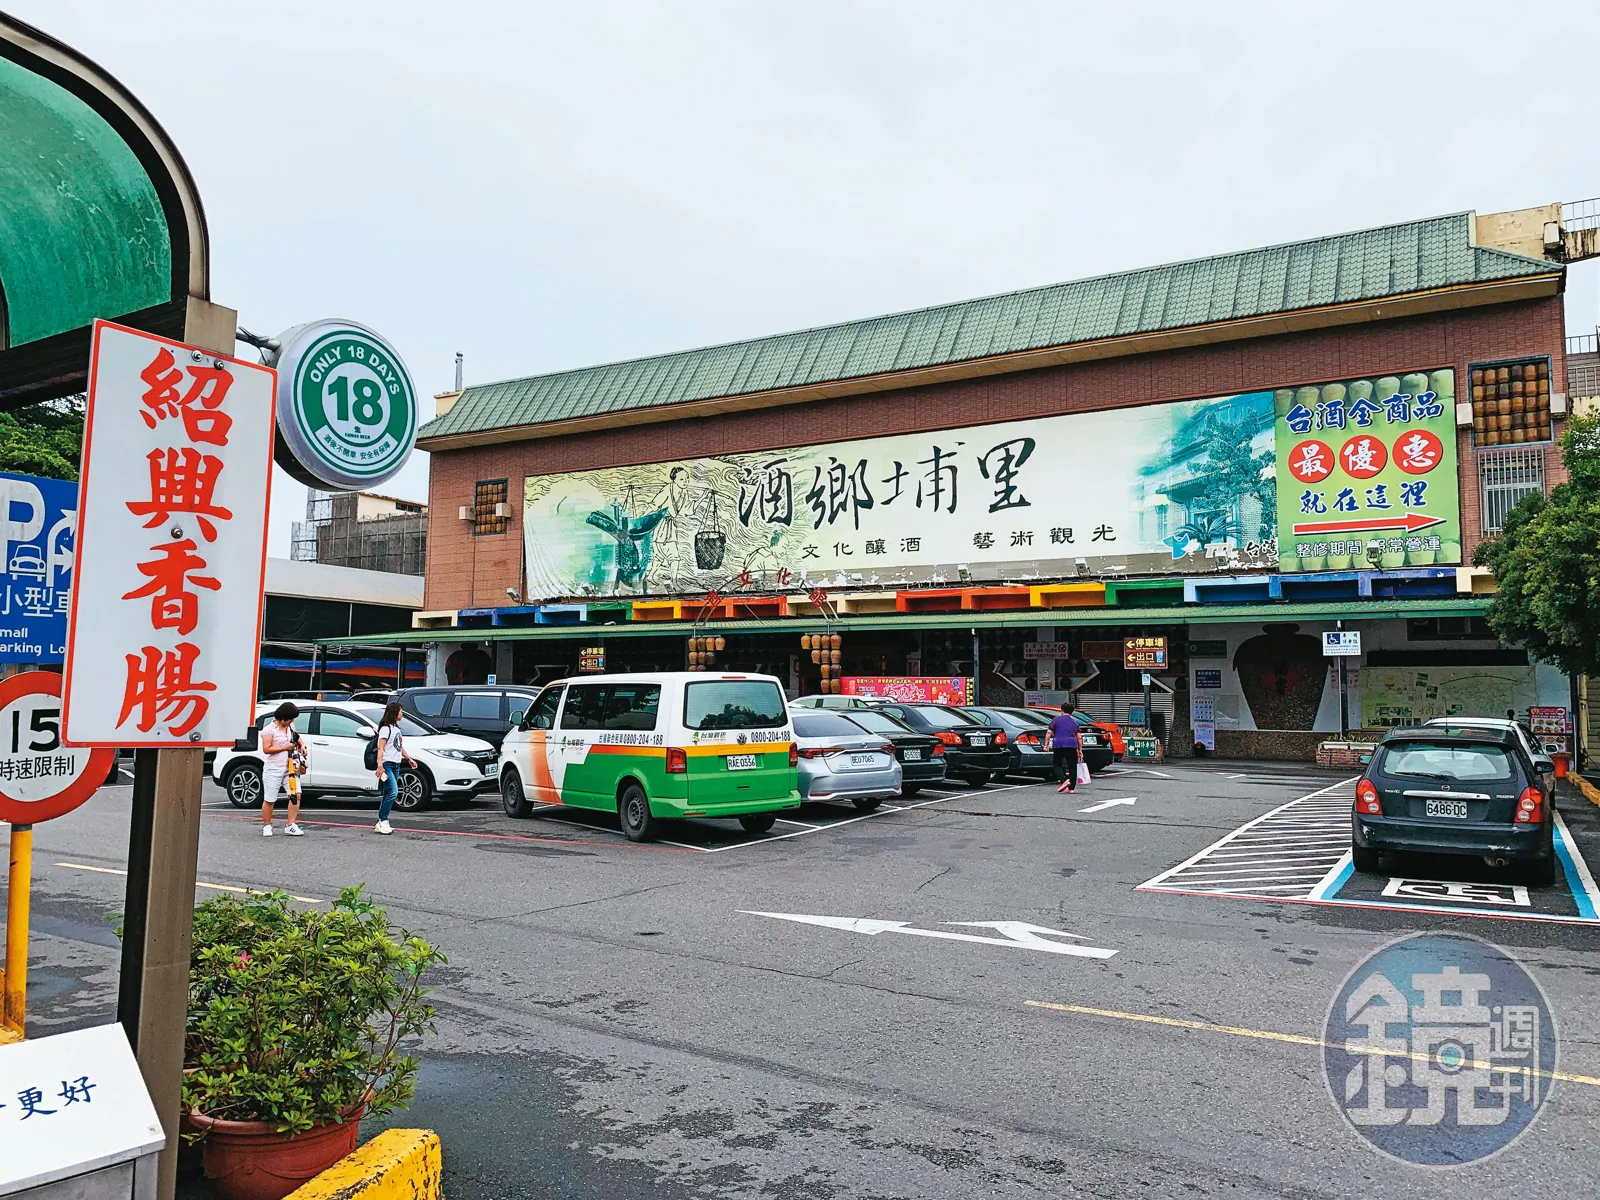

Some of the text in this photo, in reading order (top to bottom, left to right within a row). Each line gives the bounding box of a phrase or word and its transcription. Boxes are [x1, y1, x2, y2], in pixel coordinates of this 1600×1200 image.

[310, 345, 400, 395] ONLY 18 DAYS
[328, 375, 383, 426] 18
[1285, 391, 1443, 434] 台酒全商品
[323, 433, 391, 460] 酒後不開車 安全有保障
[1293, 433, 1436, 477] 最優惠
[738, 437, 1036, 530] 酒鄉埔里
[1300, 481, 1428, 514] 就在這裡
[116, 347, 235, 737] 紹興香腸
[801, 524, 1117, 559] 文化釀酒 藝術觀光
[1296, 540, 1362, 558] 整修期間
[1135, 638, 1163, 647] 停車場
[1136, 652, 1153, 660] 出口
[11, 708, 61, 752] 15
[750, 730, 791, 742] 0800-204-188
[0, 755, 75, 781] 時速限制
[1427, 803, 1467, 816] 6486-DC
[0, 1076, 97, 1121] 更好
